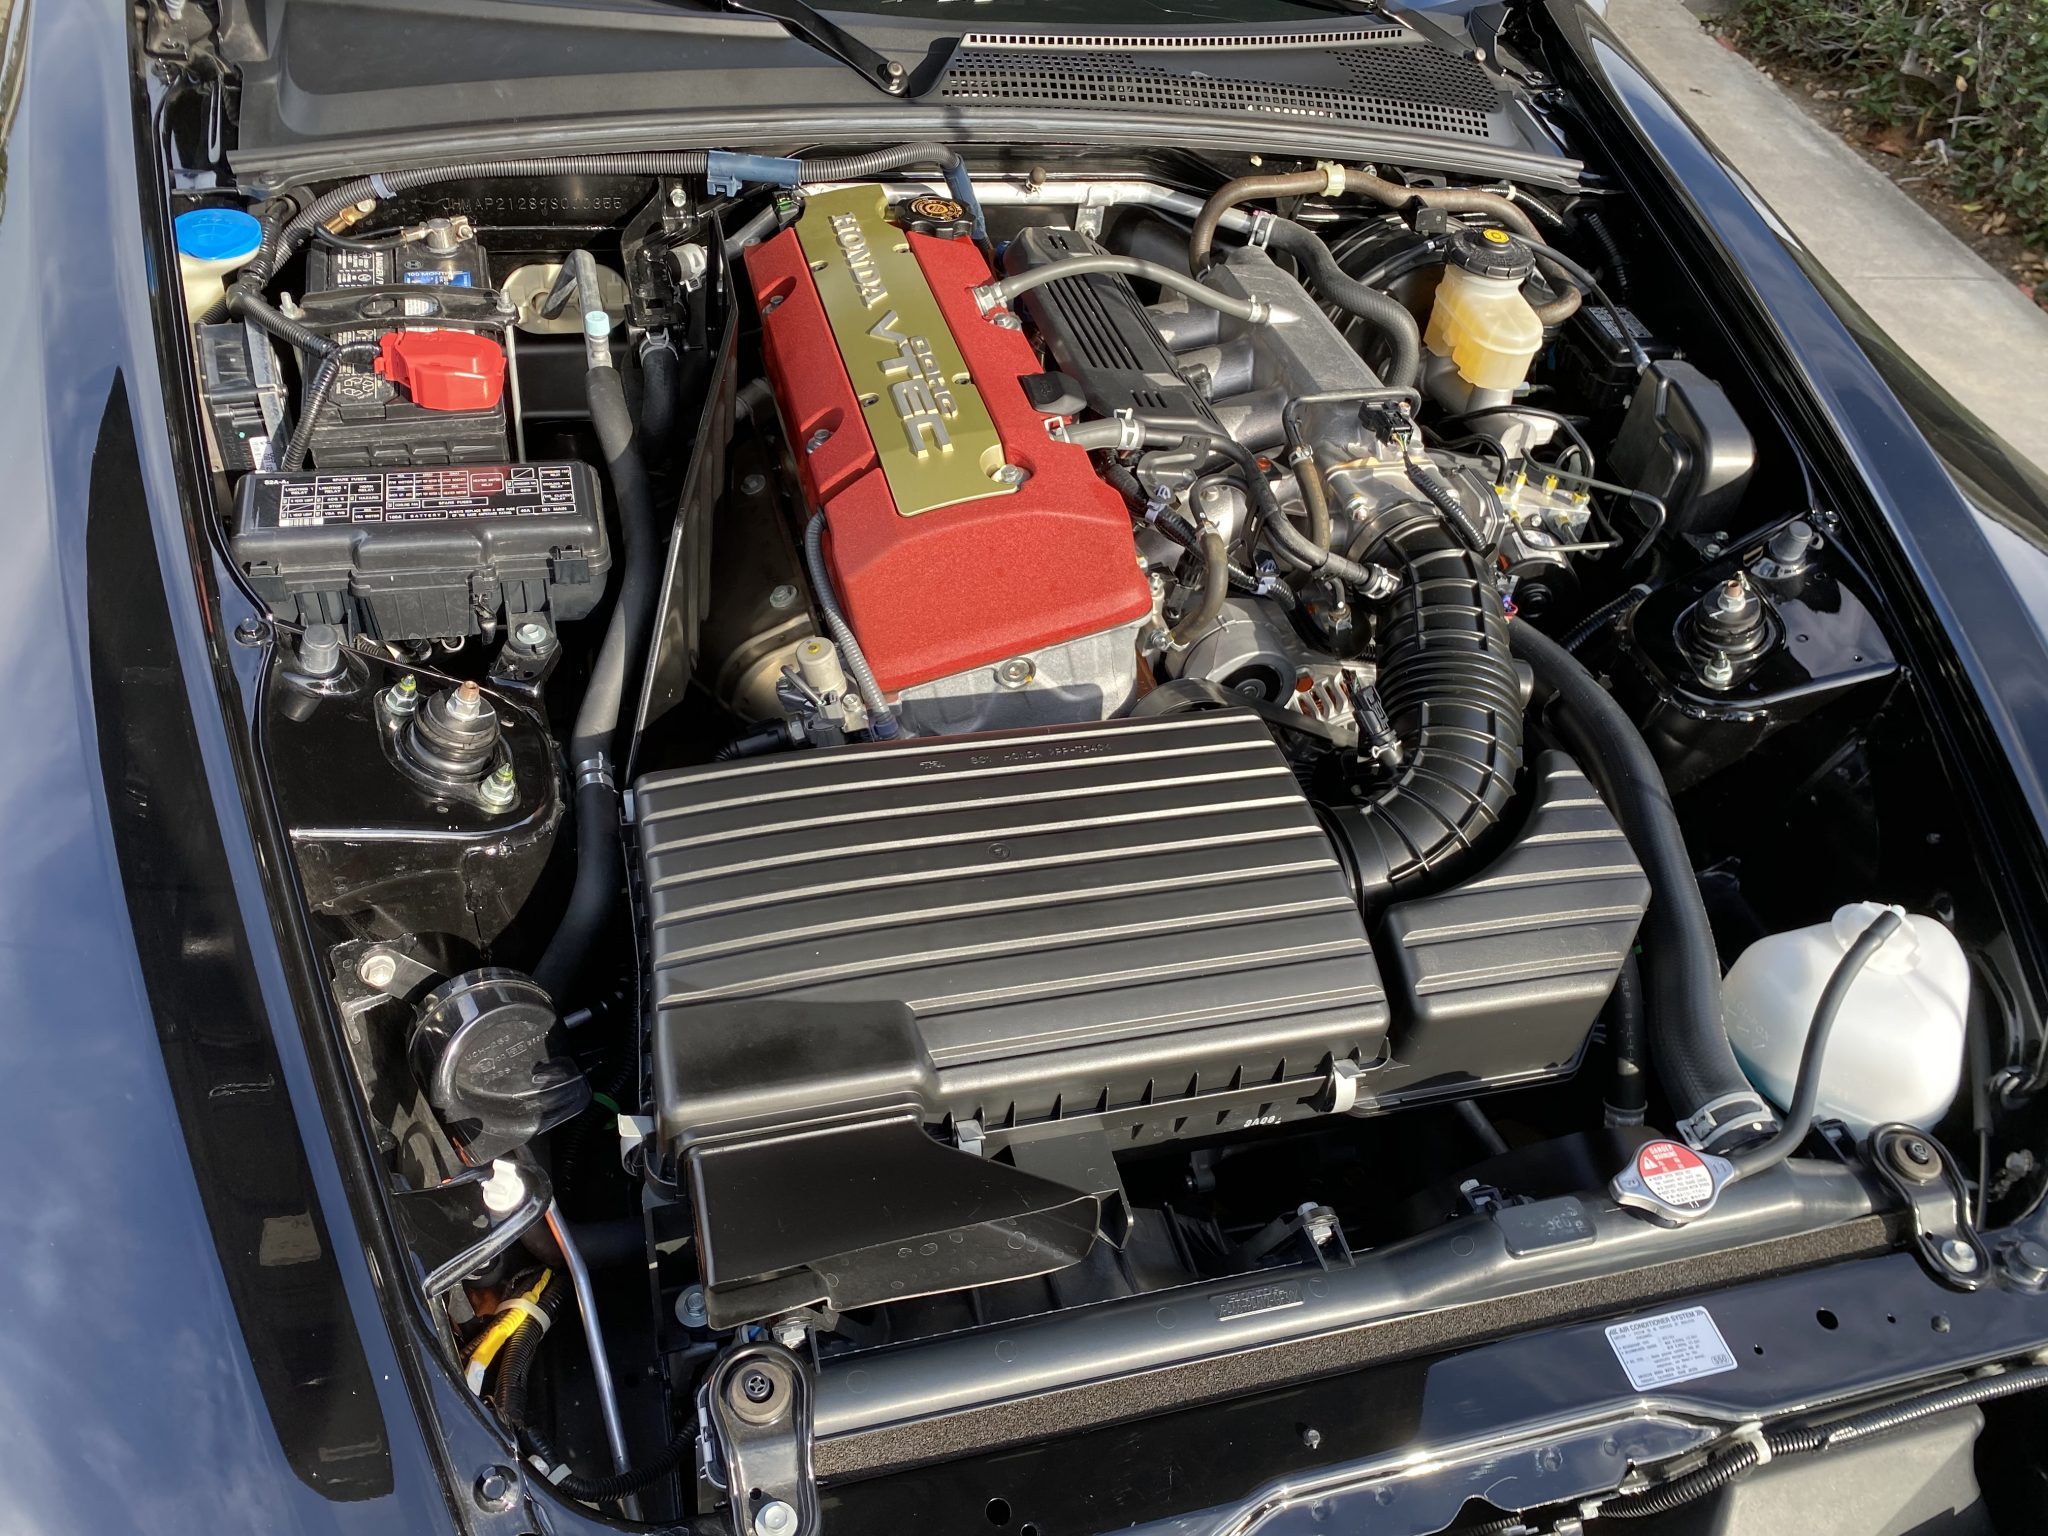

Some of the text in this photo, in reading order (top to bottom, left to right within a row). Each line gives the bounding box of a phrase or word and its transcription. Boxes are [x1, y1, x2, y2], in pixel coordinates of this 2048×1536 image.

[829, 211, 889, 310] HONDA
[867, 309, 954, 459] VTEC
[909, 335, 959, 418] DOHC
[1648, 1144, 1673, 1155] DANGER
[1619, 1325, 1630, 1334] AIR
[1630, 1316, 1670, 1331] CONDITIONER
[1670, 1310, 1696, 1322] SYSTEM
